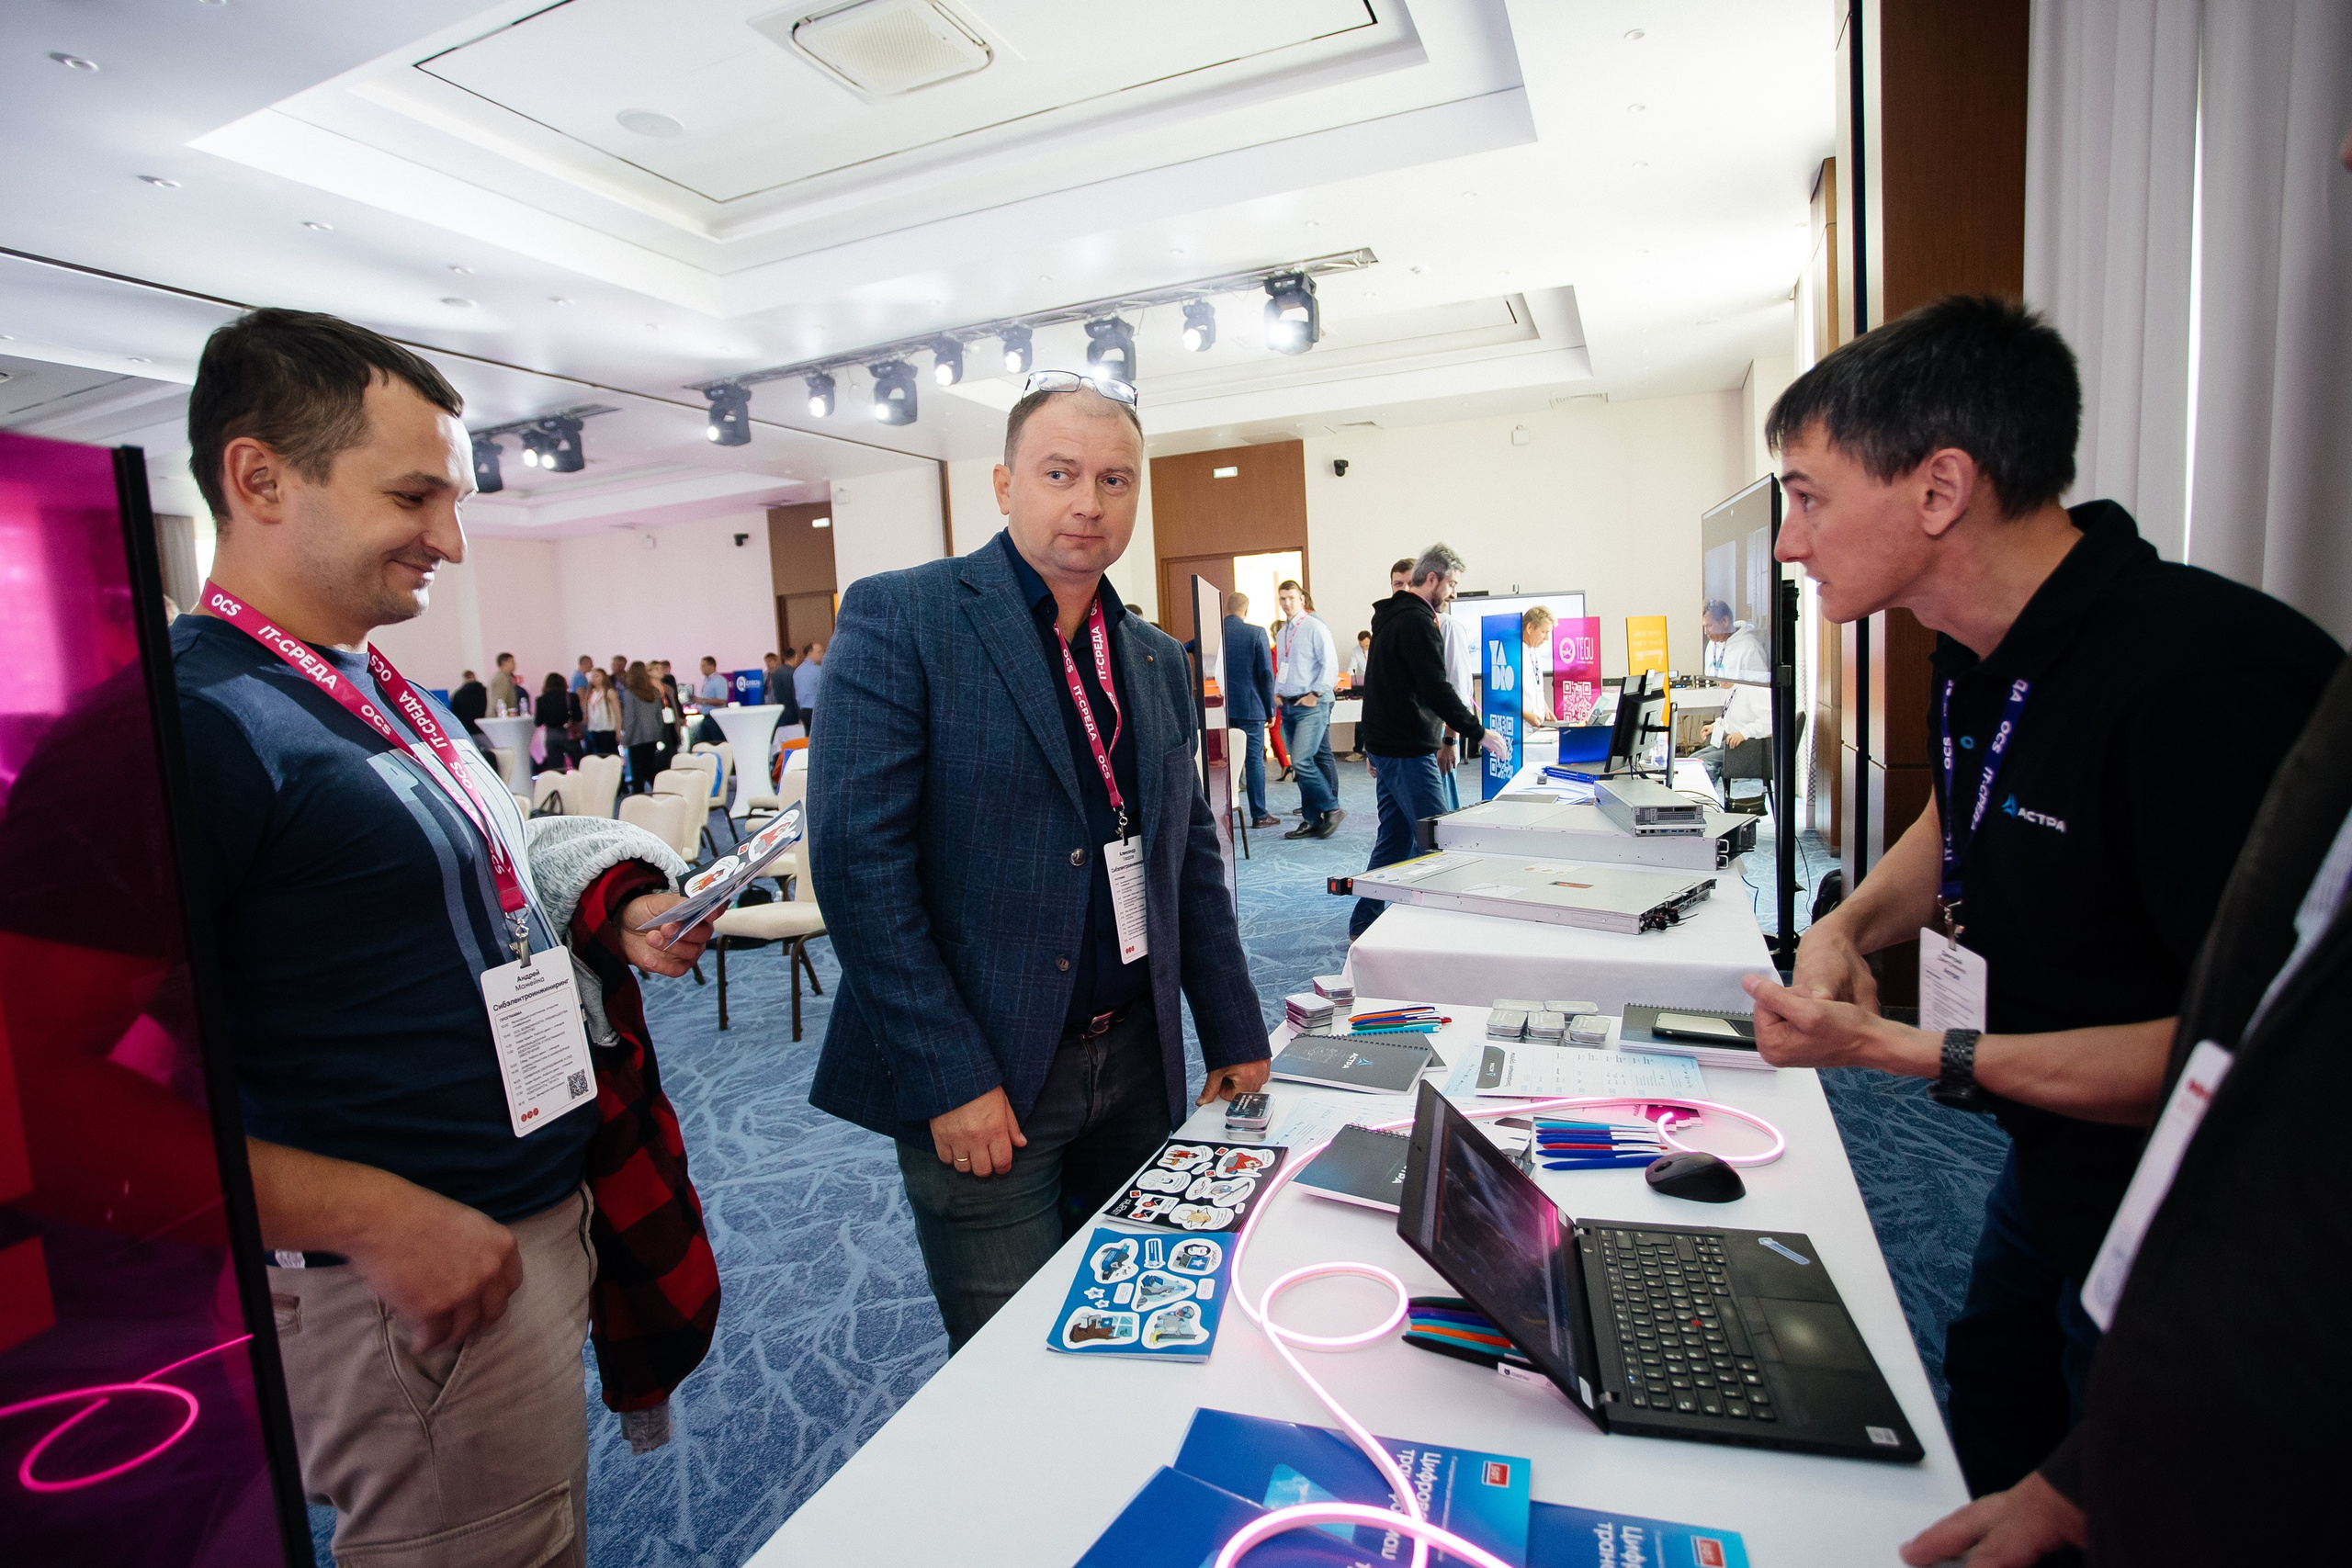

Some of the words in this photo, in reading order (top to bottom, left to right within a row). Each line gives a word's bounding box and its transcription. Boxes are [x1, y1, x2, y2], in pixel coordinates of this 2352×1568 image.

[211, 593, 242, 616] OCS
[258, 626, 339, 690] IT-СРЕДА
[1063, 649, 1074, 673] OCS
[1091, 626, 1107, 680] IT-СРЕДА
[1576, 637, 1594, 660] TEGU
[370, 654, 392, 682] OCS
[360, 705, 391, 735] OCS
[399, 691, 447, 749] IT-СРЕДА
[1072, 685, 1097, 742] IT-СРЕДА
[1992, 720, 2012, 754] OCS
[1098, 754, 1111, 780] OCS
[1942, 737, 1952, 770] OCS
[449, 761, 473, 790] OCS
[2018, 807, 2067, 833] АСТРА
[516, 968, 540, 983] Андрей
[492, 978, 570, 1012] Сибэлектроинжиниринг
